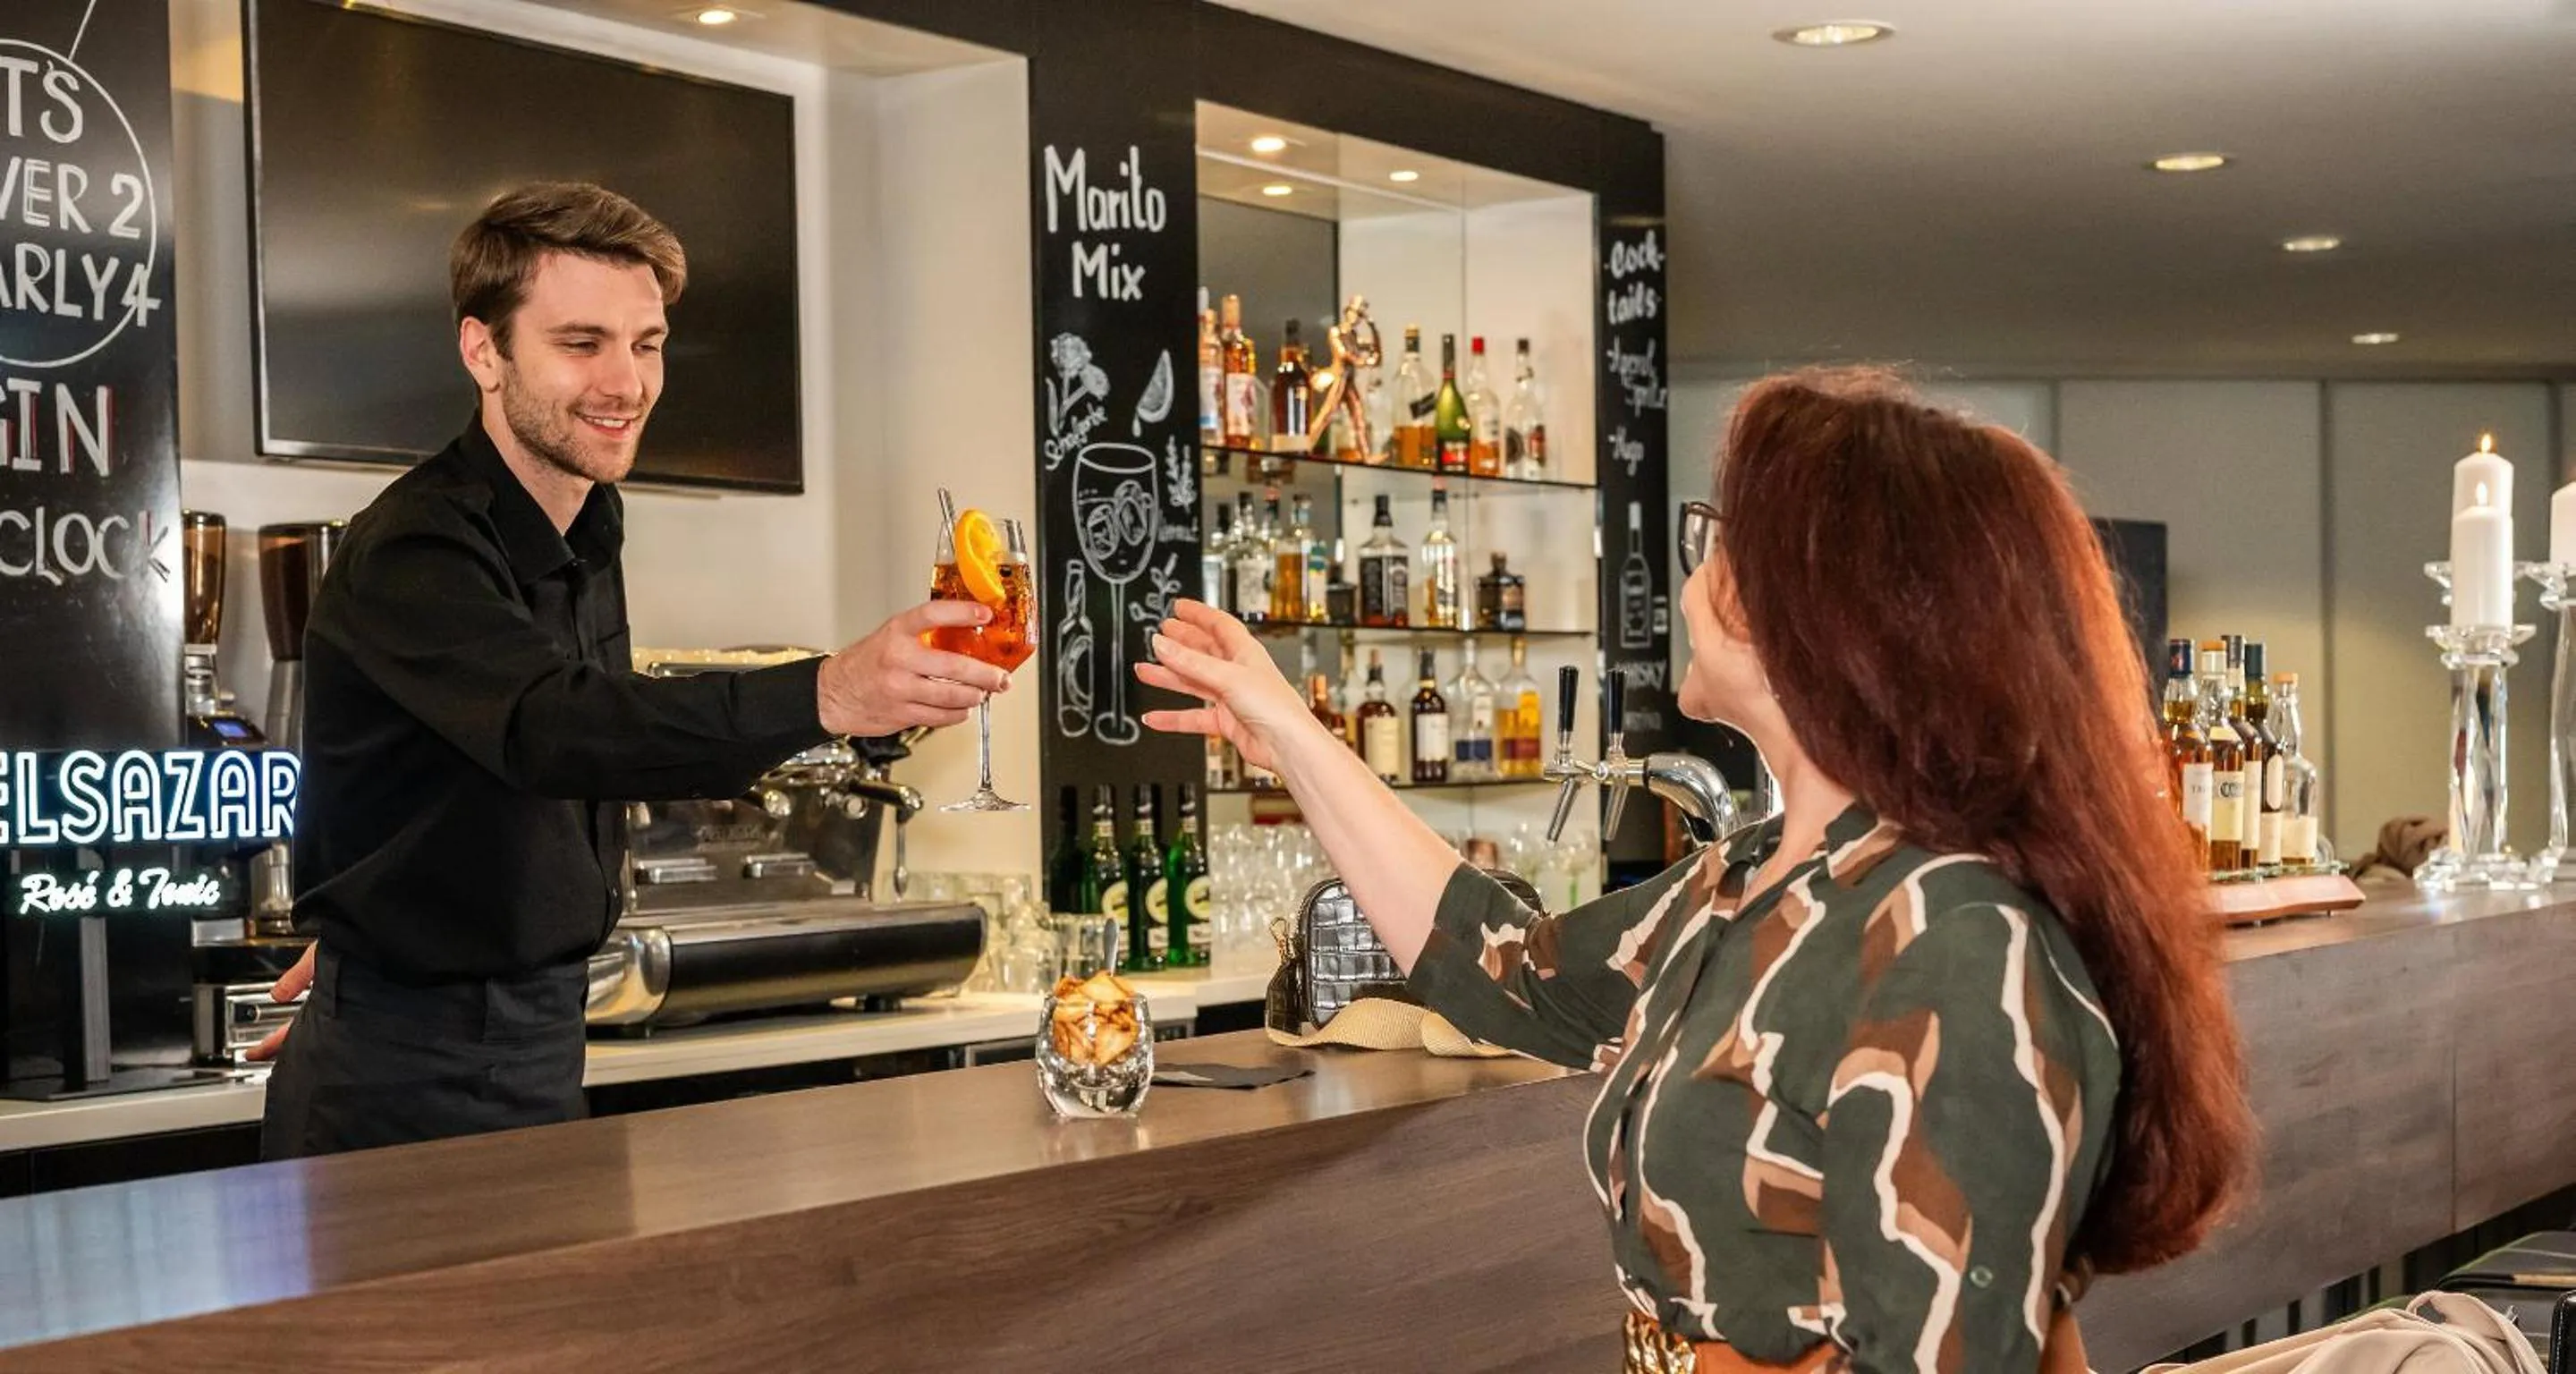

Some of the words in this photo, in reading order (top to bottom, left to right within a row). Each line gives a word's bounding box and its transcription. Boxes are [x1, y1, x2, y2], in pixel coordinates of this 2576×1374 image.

[108, 173, 144, 240] 2
[1044, 144, 1166, 233] Marito
[121, 263, 162, 327] 4
[1072, 241, 1146, 301] Mix
[0, 750, 301, 844] LSAZAR
[106, 868, 132, 906] &
[139, 867, 221, 909] Tonic
